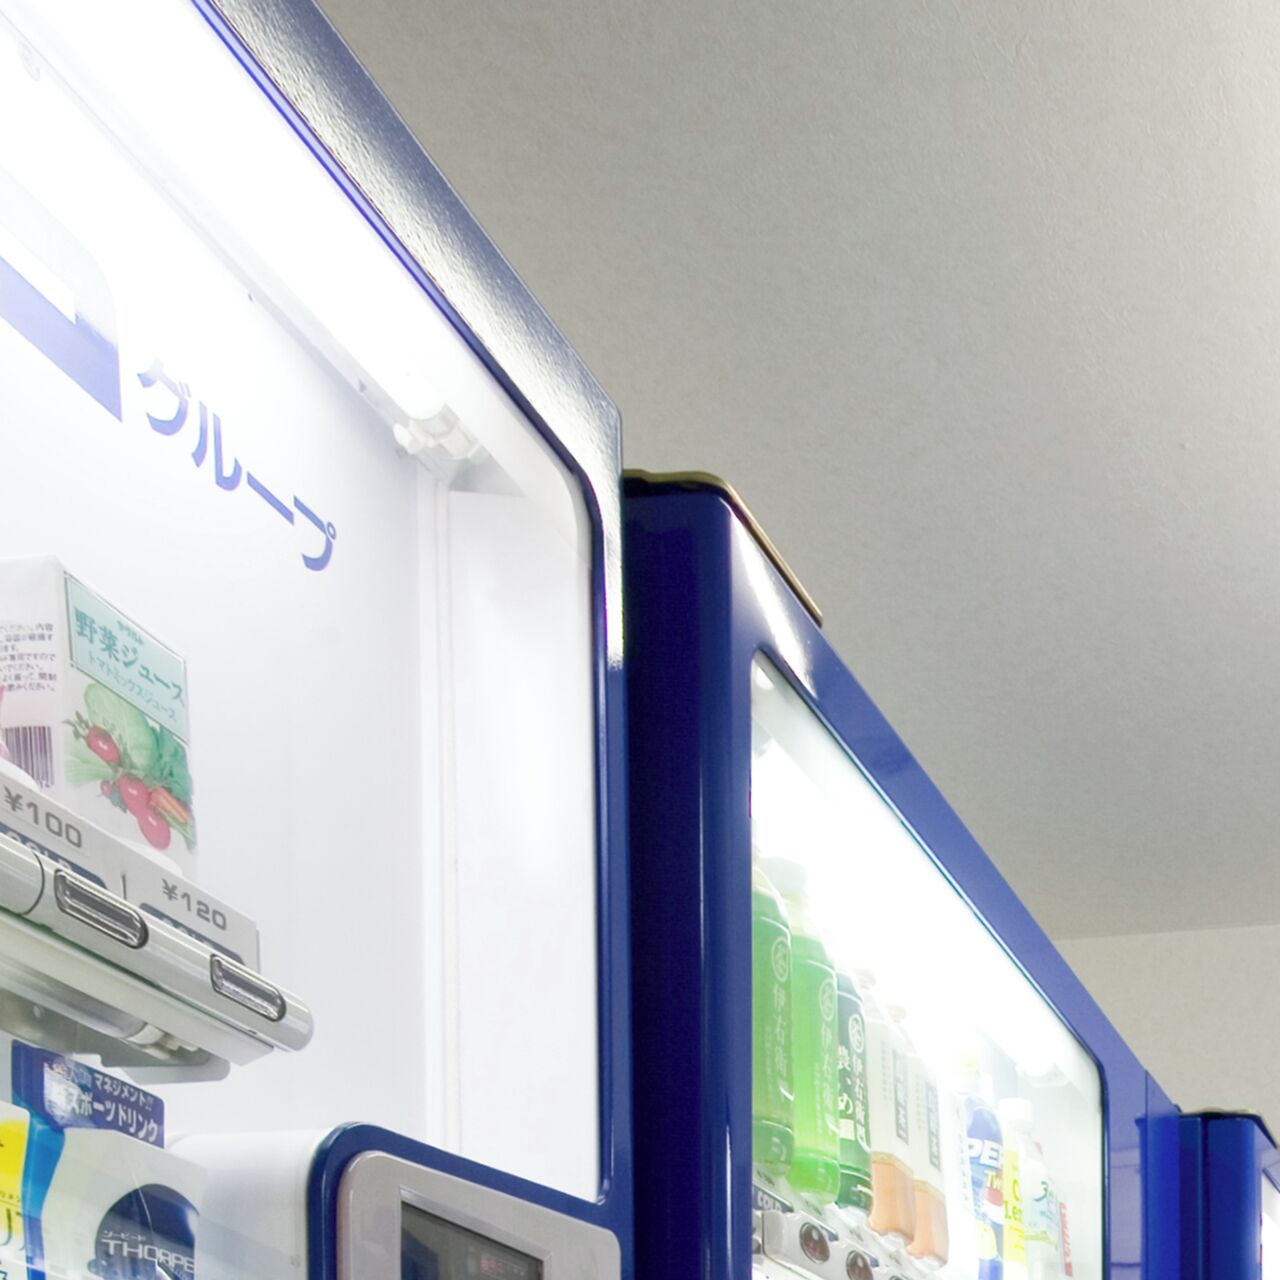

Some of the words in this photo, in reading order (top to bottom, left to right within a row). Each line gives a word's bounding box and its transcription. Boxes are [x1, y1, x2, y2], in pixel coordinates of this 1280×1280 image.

[137, 357, 337, 572] グループ
[75, 607, 185, 707] 野菜ジュース
[3, 787, 82, 849] ¥100
[162, 879, 227, 931] ¥120
[67, 1090, 158, 1142] スポーツドリンク
